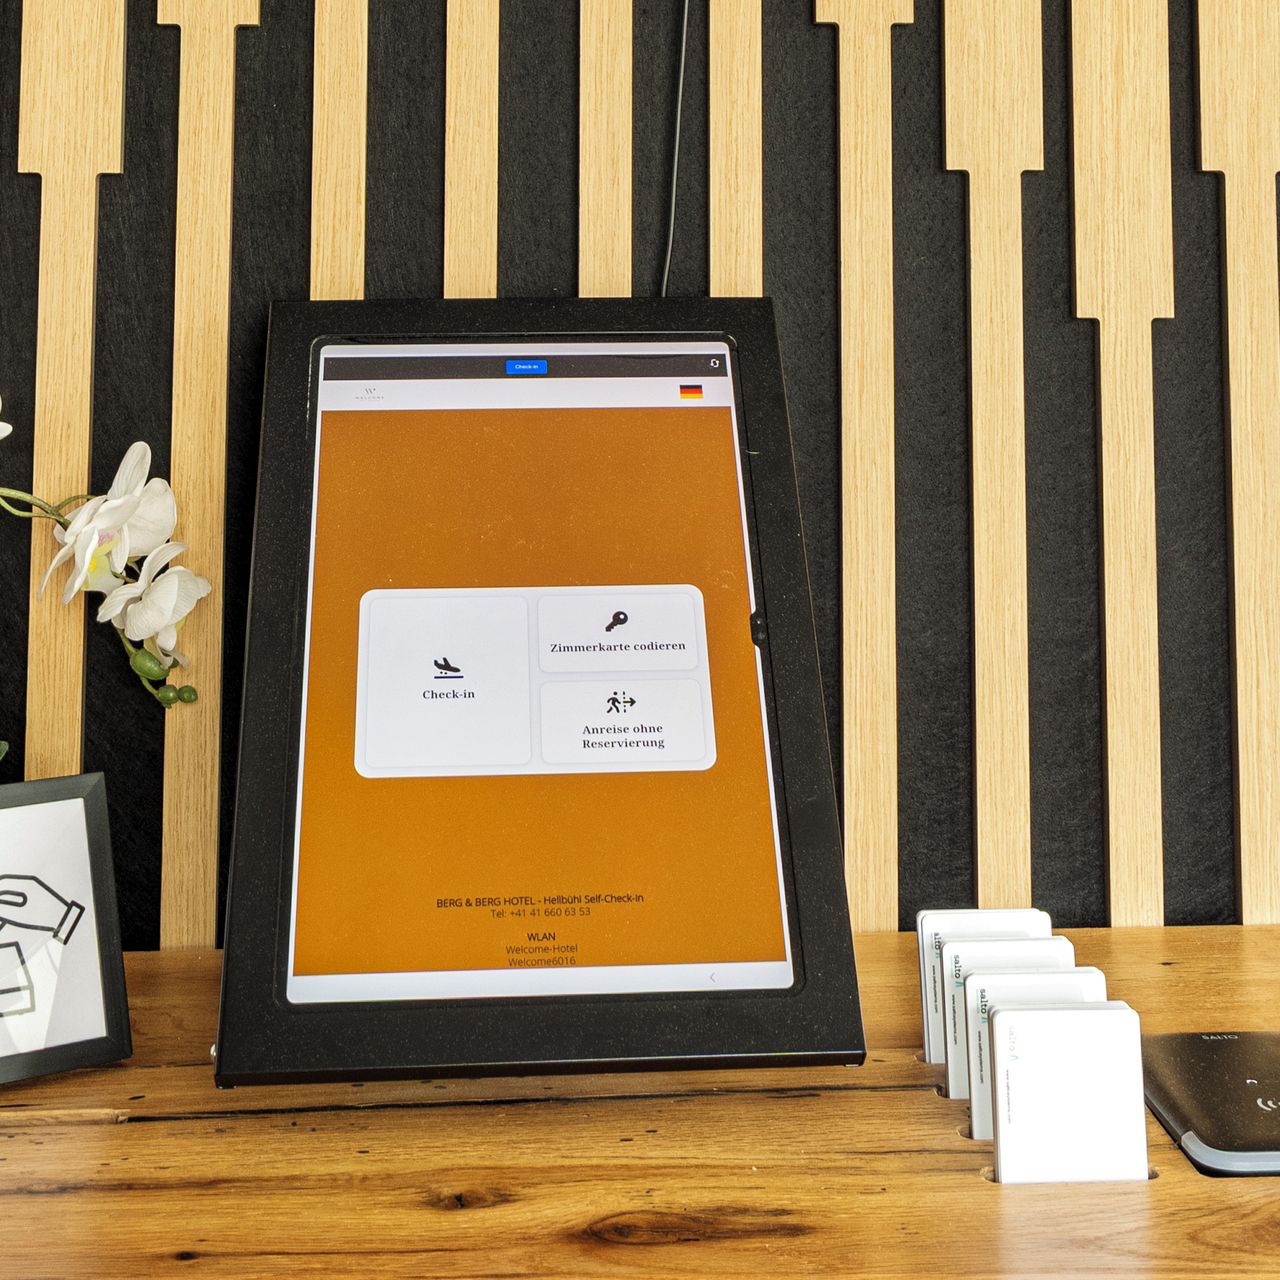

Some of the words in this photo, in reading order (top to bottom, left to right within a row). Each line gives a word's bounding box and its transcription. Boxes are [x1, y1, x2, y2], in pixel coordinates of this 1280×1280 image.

[550, 641, 631, 653] Zimmerkarte
[633, 641, 686, 652] codieren
[422, 689, 476, 700] Check-in
[582, 724, 630, 735] Anreise
[633, 723, 664, 734] ohne
[582, 738, 666, 750] Reservierung
[437, 898, 463, 908] BERG
[475, 897, 501, 907] BERG
[503, 896, 535, 906] HOTEL
[491, 909, 506, 918] Tel:
[510, 908, 526, 918] +41
[529, 908, 541, 917] 41
[544, 908, 562, 917] 660
[564, 907, 576, 917] 63
[579, 907, 591, 916] 53
[527, 932, 556, 942] WLAN
[506, 944, 578, 955] Welcome-Hotel
[508, 956, 576, 967] Welcome6016
[980, 988, 989, 1014] salto
